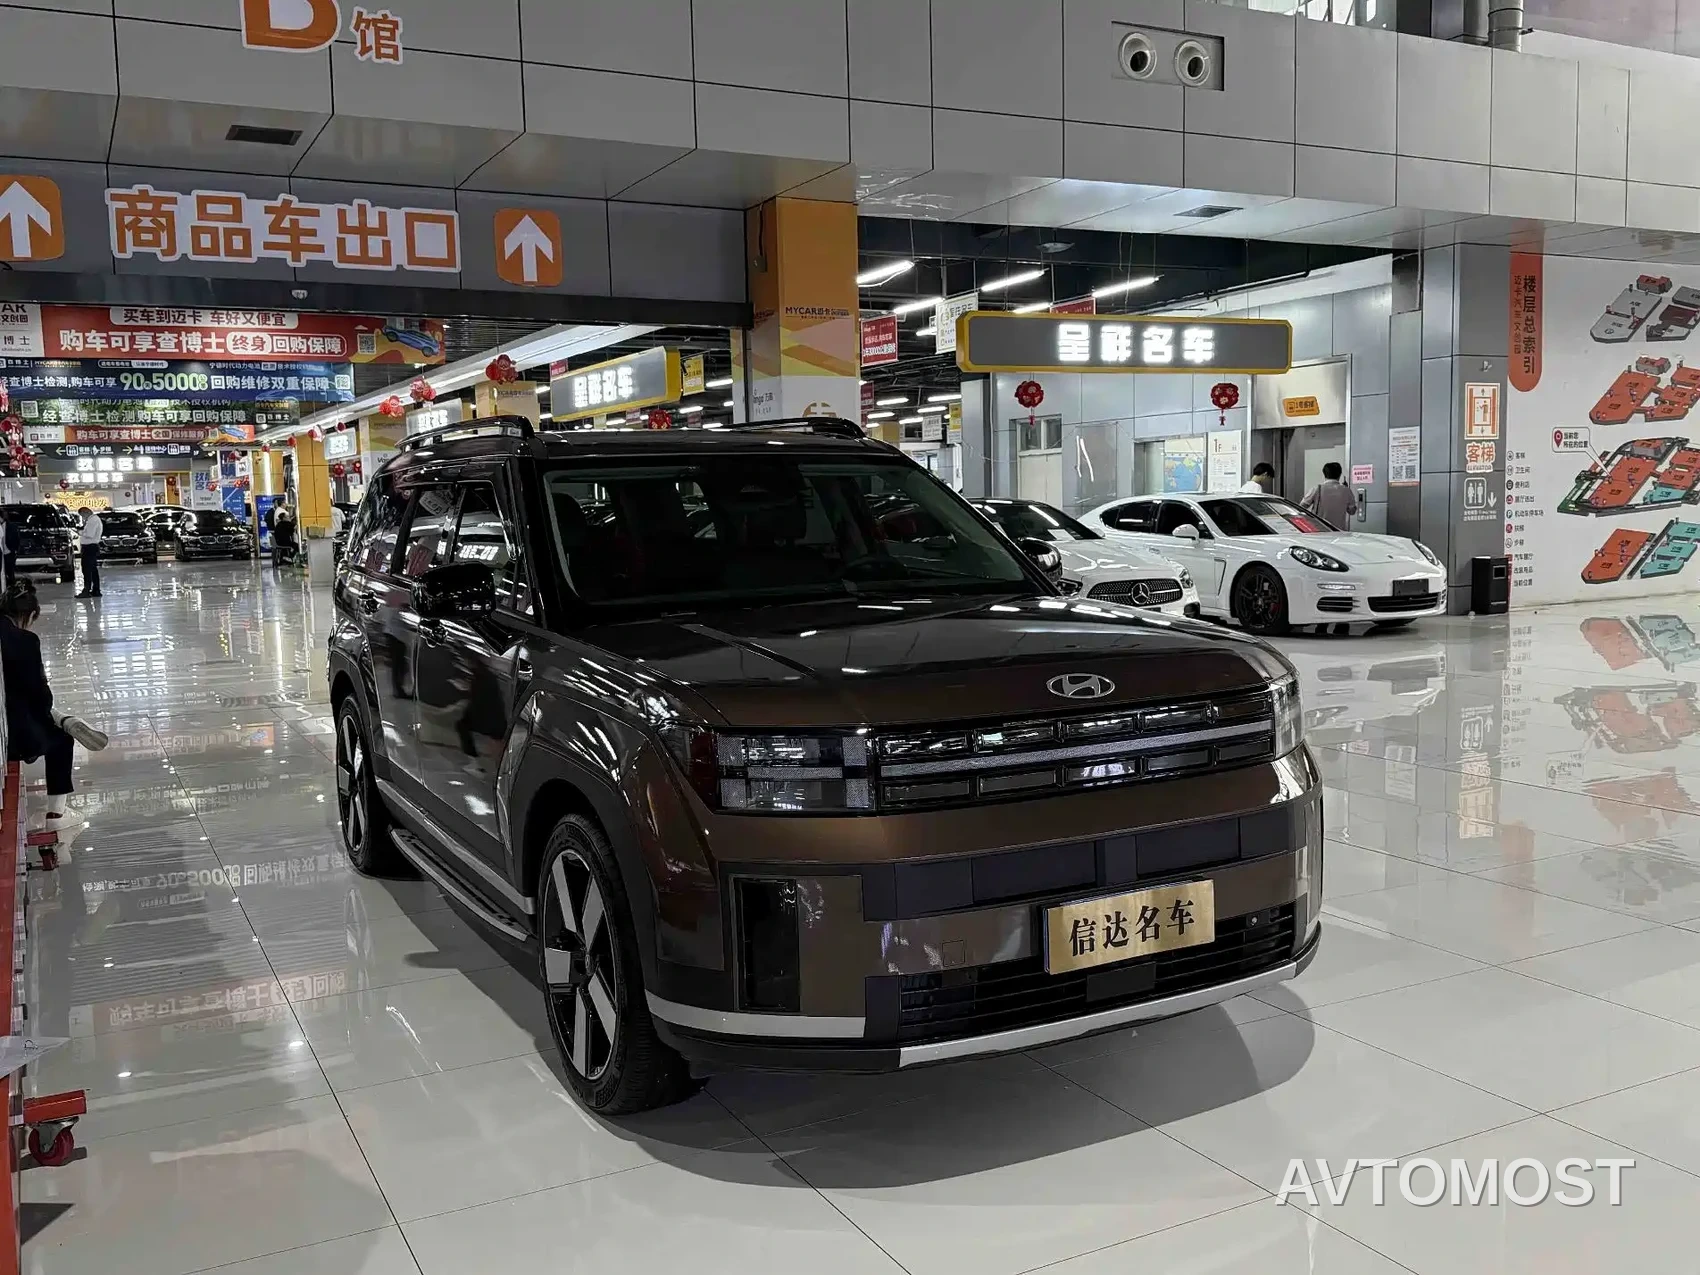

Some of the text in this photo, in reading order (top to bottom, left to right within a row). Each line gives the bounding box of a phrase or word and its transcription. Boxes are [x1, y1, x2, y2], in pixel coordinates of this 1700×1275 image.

[107, 186, 460, 272] 商品车出口
[123, 308, 287, 328] 买车到迈卡 车好又便宜
[1522, 274, 1537, 374] 楼层总索引
[1467, 442, 1495, 463] 客梯
[1563, 440, 1589, 449] 所在的位置
[1515, 466, 1531, 474] 卫生间
[1068, 899, 1195, 957] 信达名车
